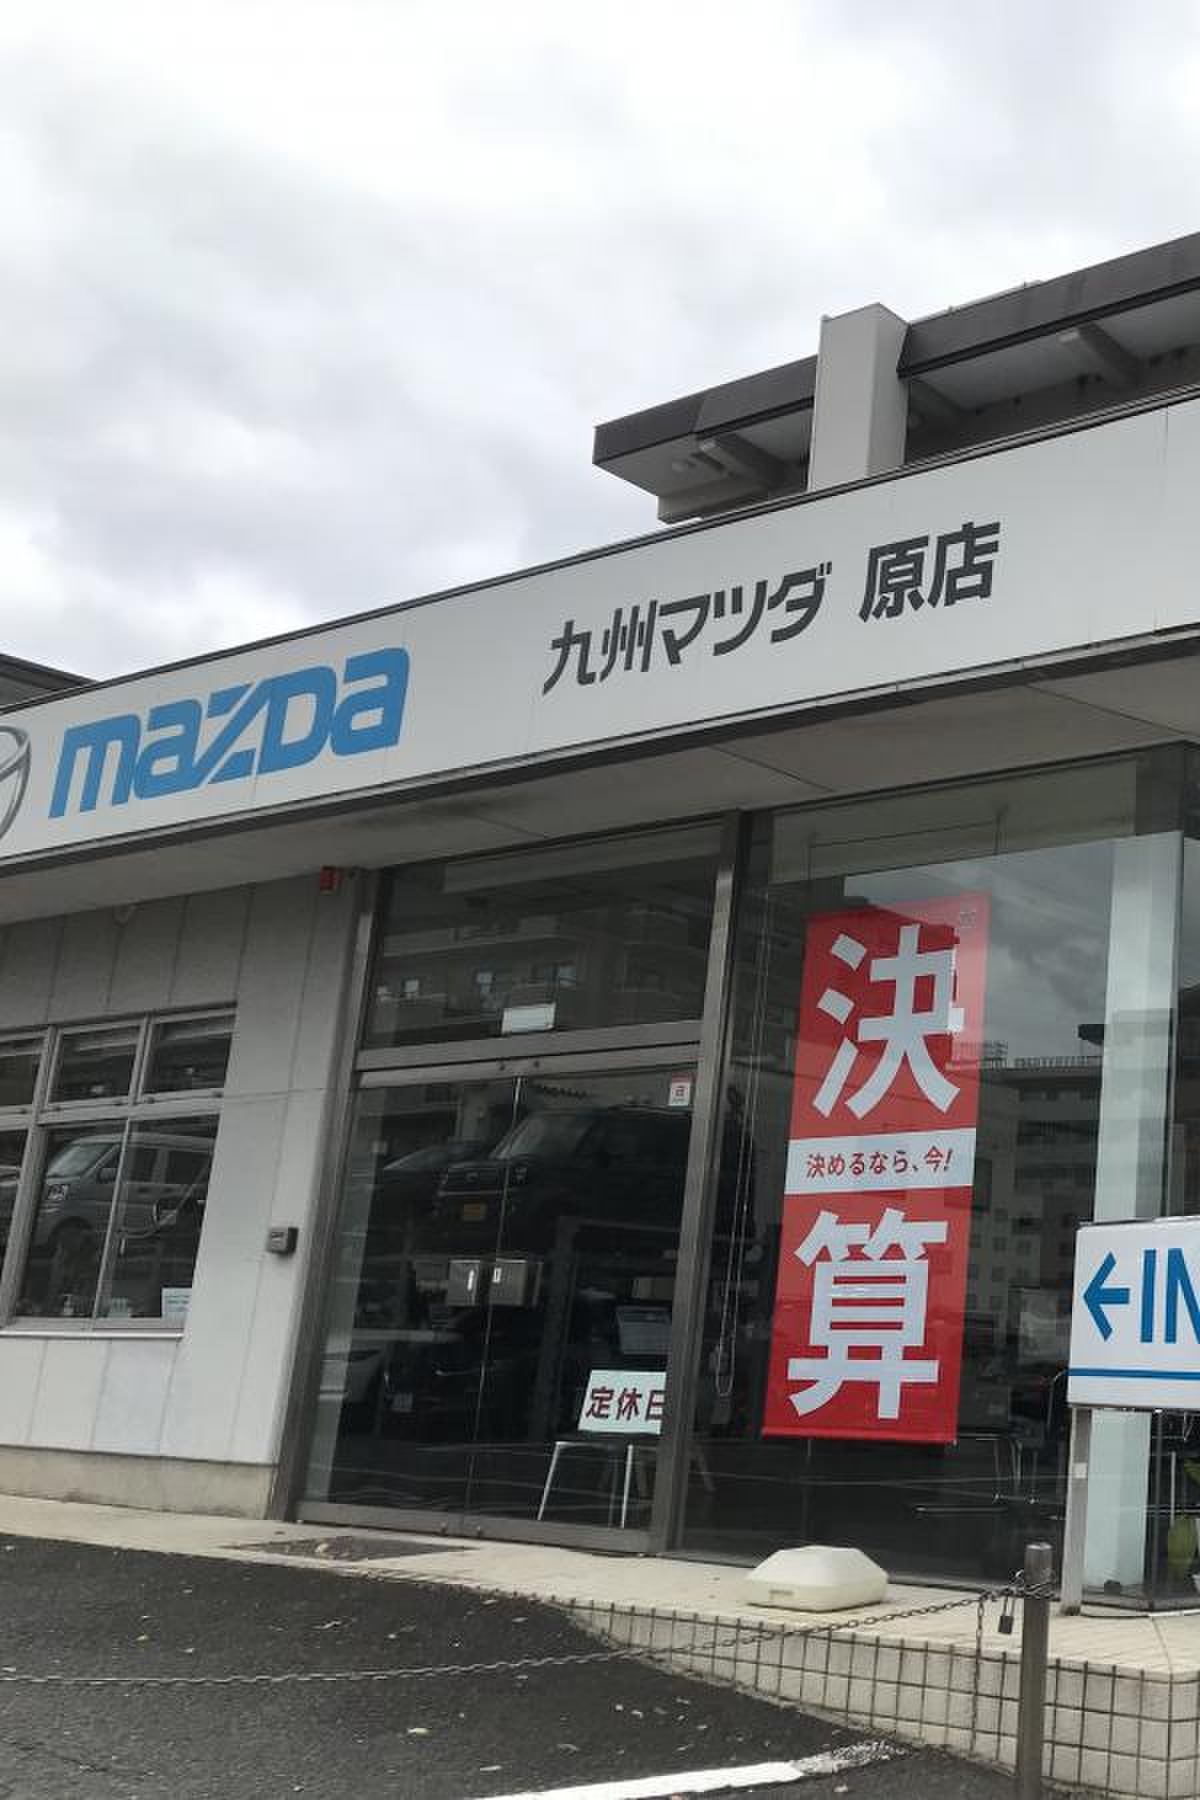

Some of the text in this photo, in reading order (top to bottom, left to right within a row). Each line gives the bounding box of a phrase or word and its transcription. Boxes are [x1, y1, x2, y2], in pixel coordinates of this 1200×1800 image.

[542, 521, 1001, 696] 九州マツダ 原店
